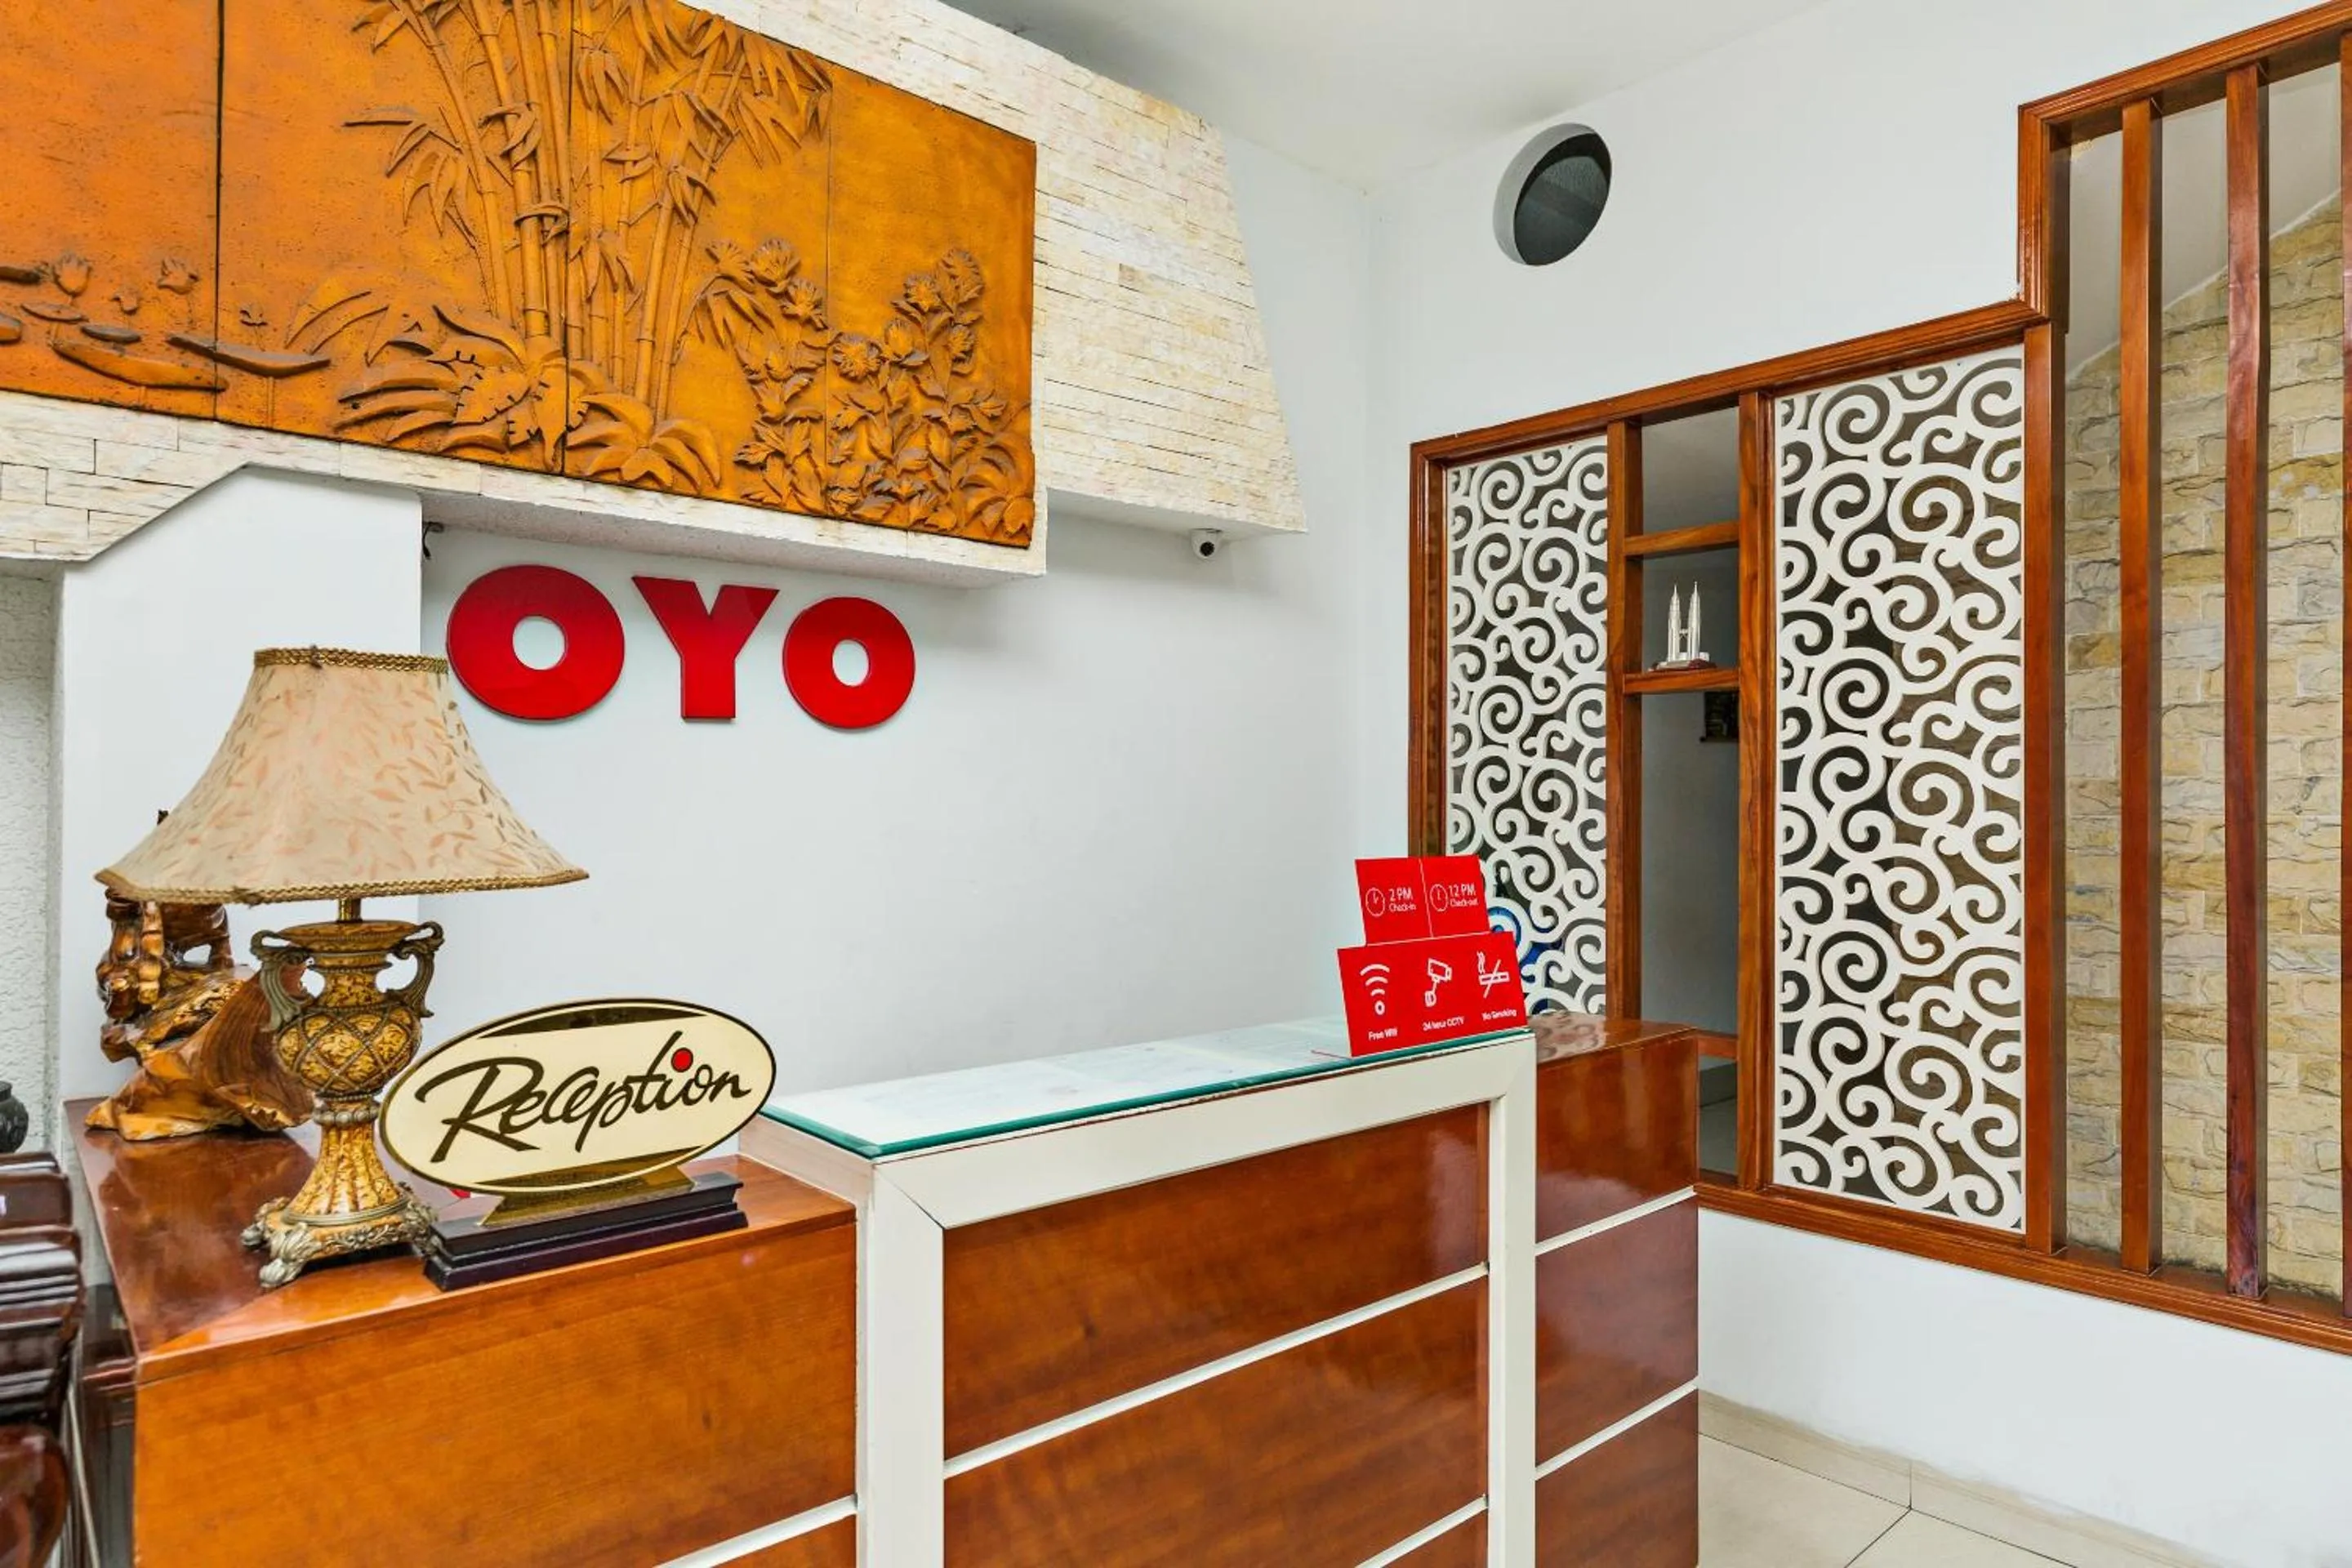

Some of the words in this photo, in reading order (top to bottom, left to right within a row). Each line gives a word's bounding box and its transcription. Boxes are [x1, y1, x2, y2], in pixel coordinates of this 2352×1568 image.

[446, 564, 915, 728] OYO
[1389, 888, 1396, 902] 2
[1397, 887, 1414, 900] PM
[1448, 884, 1459, 897] 12
[1460, 883, 1477, 896] PM
[1388, 902, 1417, 912] Check-in
[1450, 898, 1479, 907] Check-out
[1492, 1008, 1517, 1019] Smoking
[1446, 1016, 1464, 1027] CCTV
[1368, 1030, 1383, 1041] Free
[413, 1031, 751, 1163] Reception
